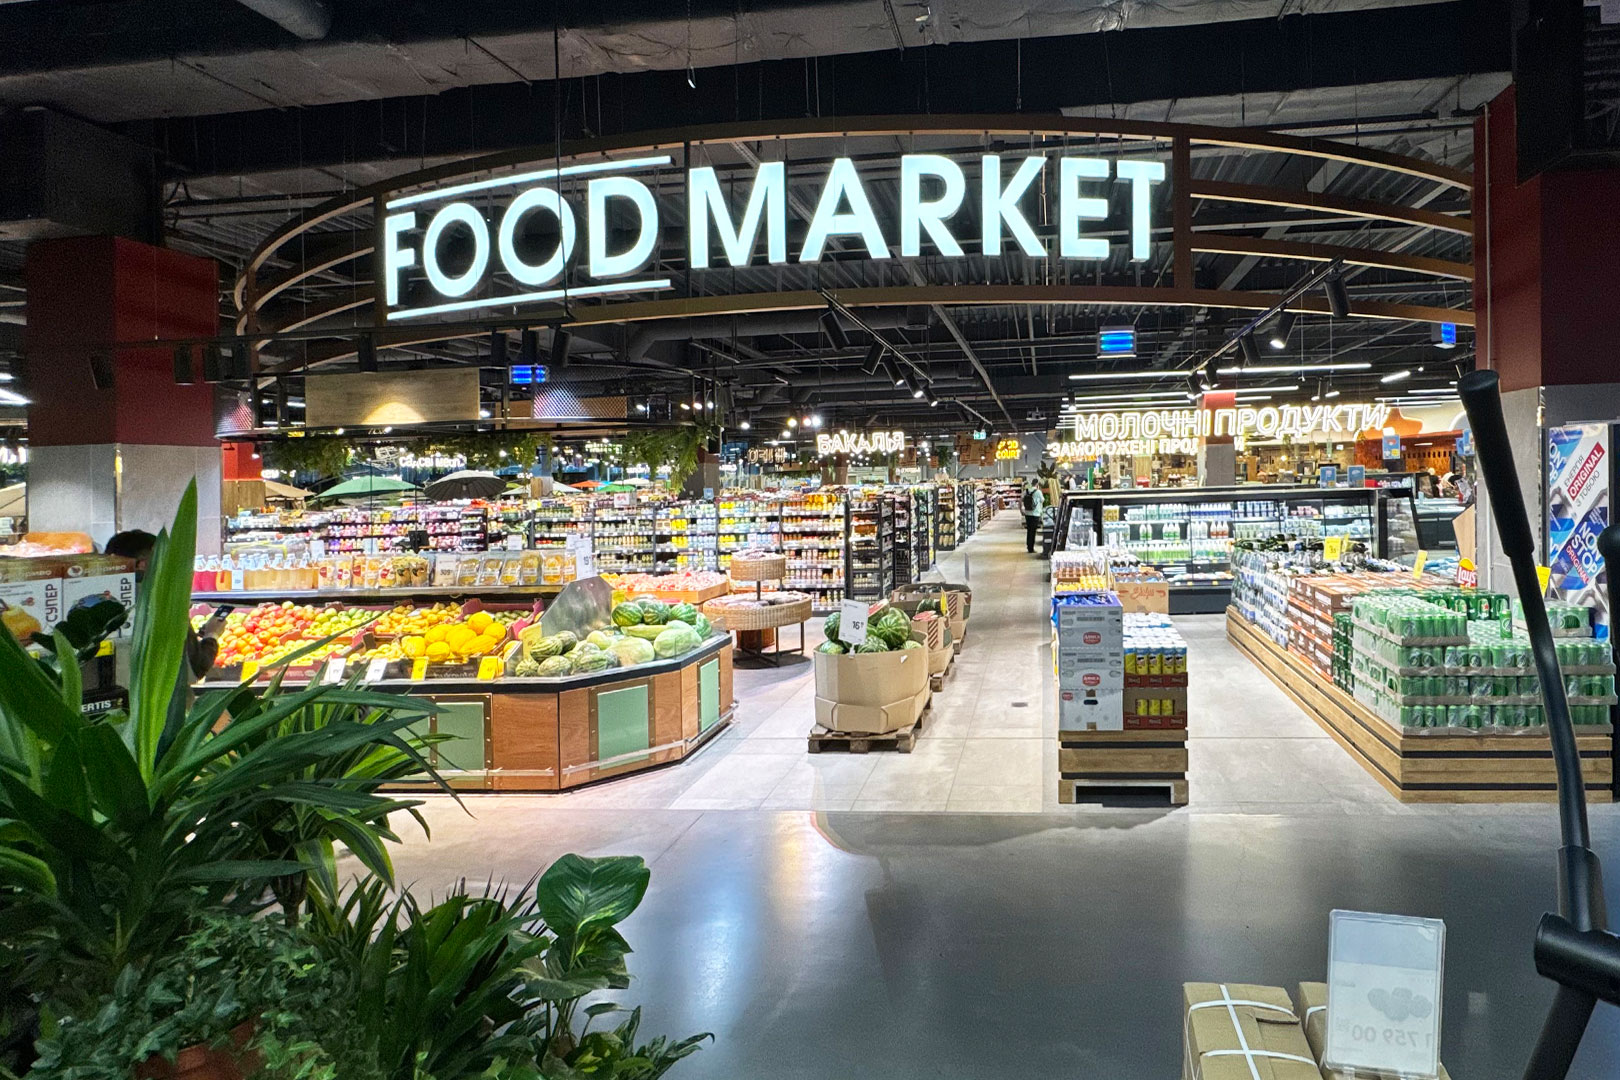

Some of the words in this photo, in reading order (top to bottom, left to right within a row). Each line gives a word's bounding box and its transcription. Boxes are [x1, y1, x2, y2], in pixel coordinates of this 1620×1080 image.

[384, 176, 659, 307] FOOD
[688, 153, 1166, 269] MARKET
[1074, 409, 1211, 442] МОЛОЧНІ
[1213, 403, 1387, 439] ПРОДУКТИ
[1048, 438, 1158, 458] ЗАМОРОЖЕНІ
[1569, 449, 1603, 496] ORIGINAL
[1571, 534, 1597, 573] STOP
[1579, 521, 1602, 562] NON
[1565, 544, 1589, 584] ORIGINAL
[45, 583, 58, 622] СУПЕР
[120, 577, 132, 607] УПЕР
[81, 700, 112, 713] ERTIS
